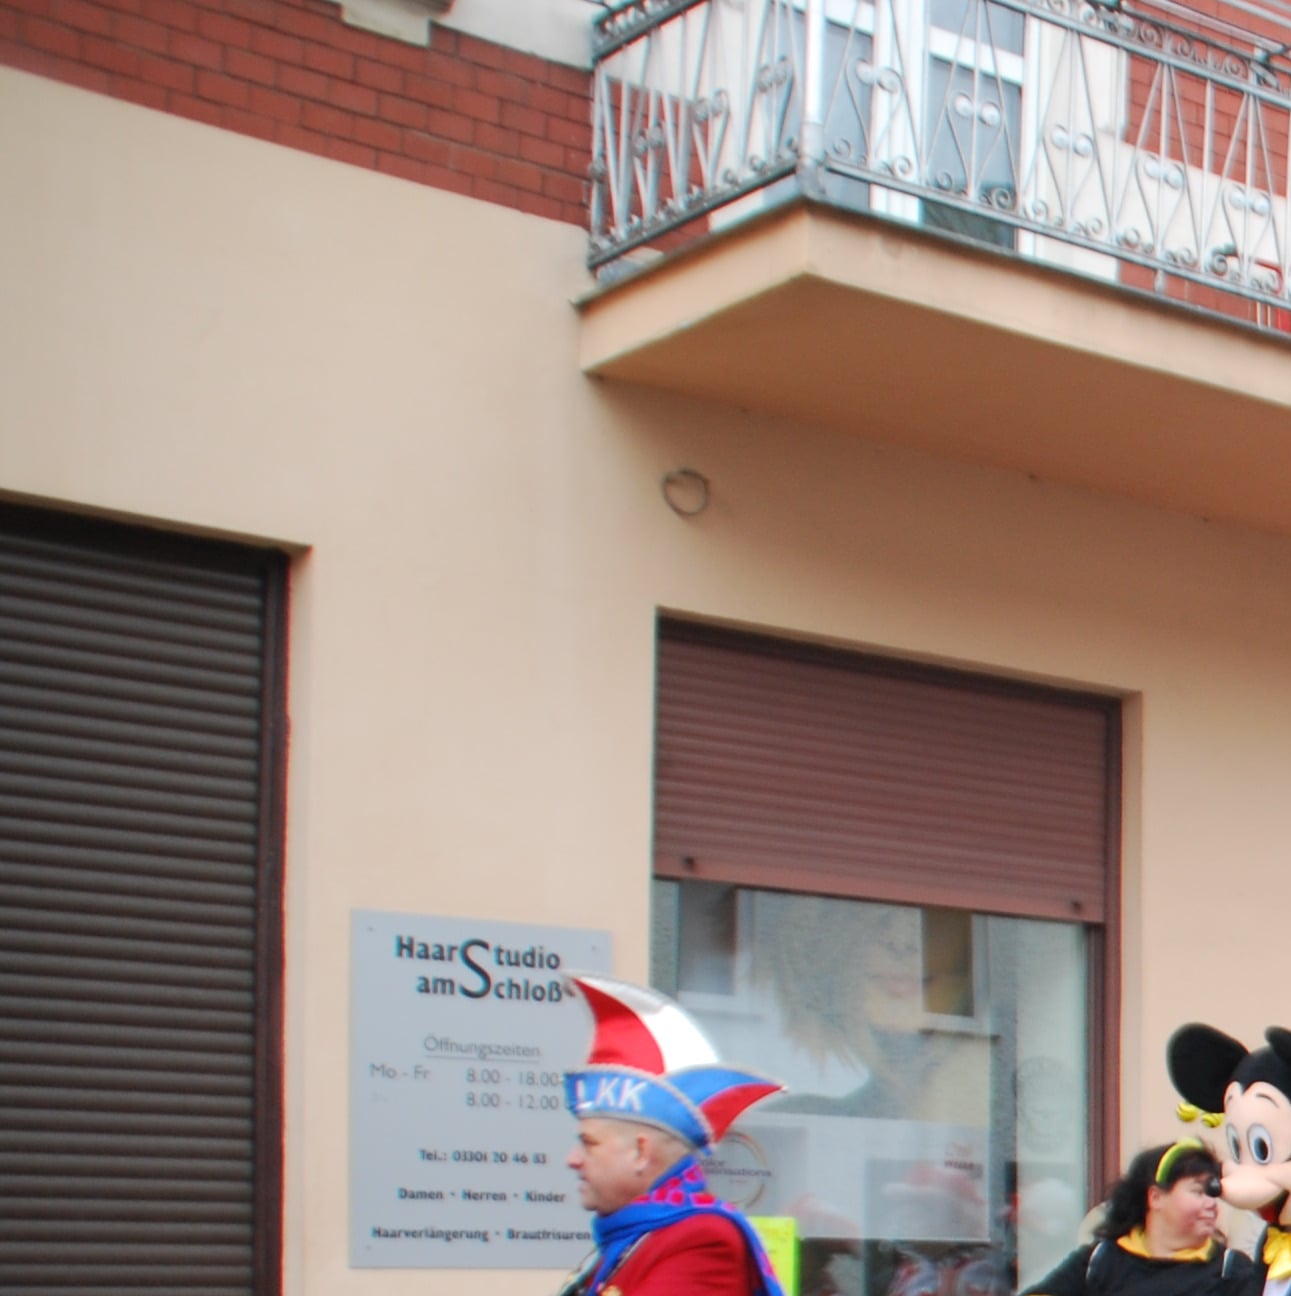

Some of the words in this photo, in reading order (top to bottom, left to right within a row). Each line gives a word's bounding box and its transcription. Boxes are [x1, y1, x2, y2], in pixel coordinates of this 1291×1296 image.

[423, 1034, 541, 1060] Öffnungszeiten
[369, 1064, 397, 1080] Mo
[414, 1065, 430, 1080] Fr
[576, 1077, 647, 1112] LKK
[398, 1187, 444, 1200] Damen
[461, 1189, 507, 1202] Herren
[525, 1190, 566, 1203] Kinder
[371, 1226, 489, 1242] Haarverlängerung
[506, 1228, 591, 1241] Brautfrisuren
